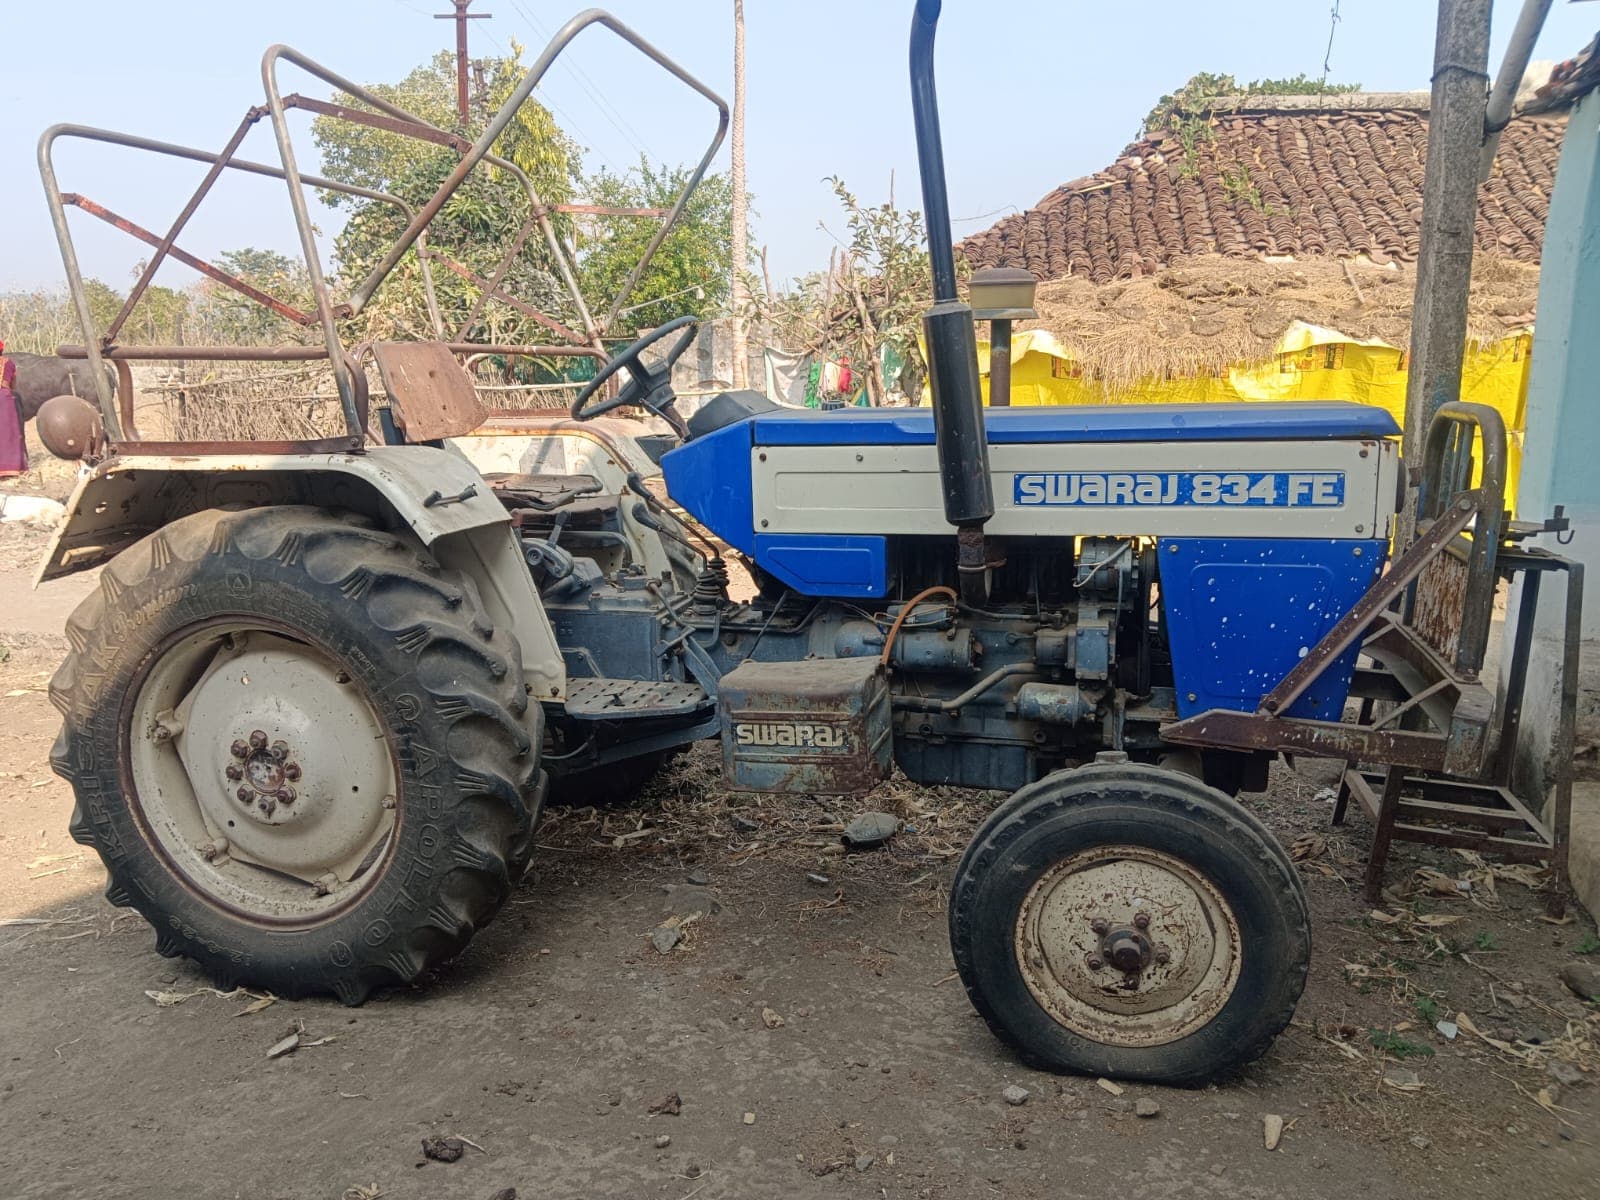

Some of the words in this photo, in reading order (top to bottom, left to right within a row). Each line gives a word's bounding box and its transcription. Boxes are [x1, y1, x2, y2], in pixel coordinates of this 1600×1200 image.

[1190, 475, 1277, 503] 834
[1287, 475, 1340, 506] FE
[75, 638, 128, 861] KRISHAK
[362, 742, 444, 948] APOLLO
